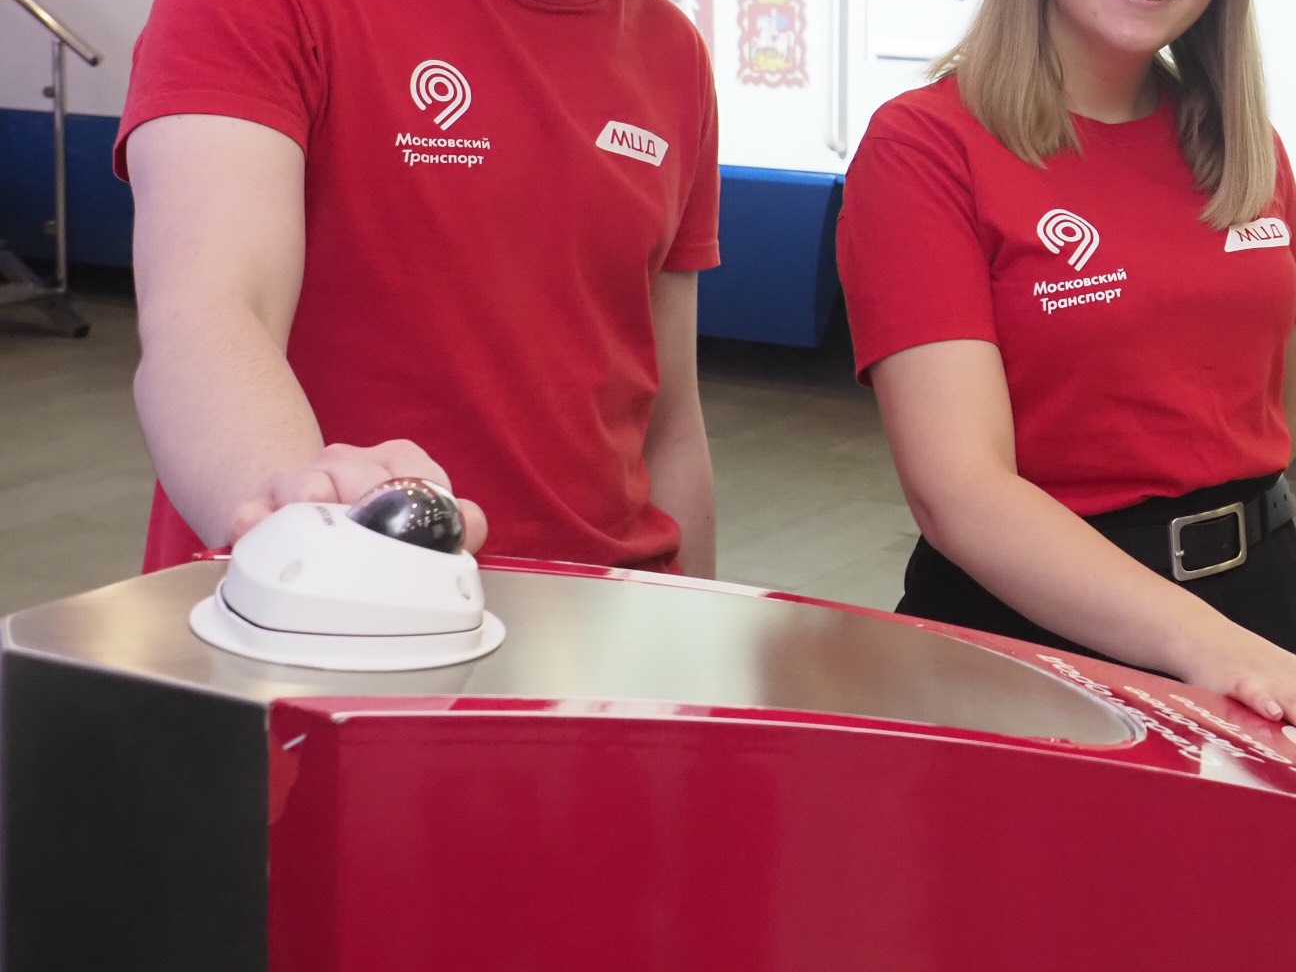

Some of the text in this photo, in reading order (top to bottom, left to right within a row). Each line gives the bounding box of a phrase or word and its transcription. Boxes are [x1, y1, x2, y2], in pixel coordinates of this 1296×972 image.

[395, 132, 491, 150] Московский
[609, 128, 658, 158] МЦД
[402, 149, 484, 168] Транспорт
[1236, 223, 1284, 243] МЦД
[1033, 268, 1128, 296] Московский
[1040, 287, 1122, 315] Транспорт
